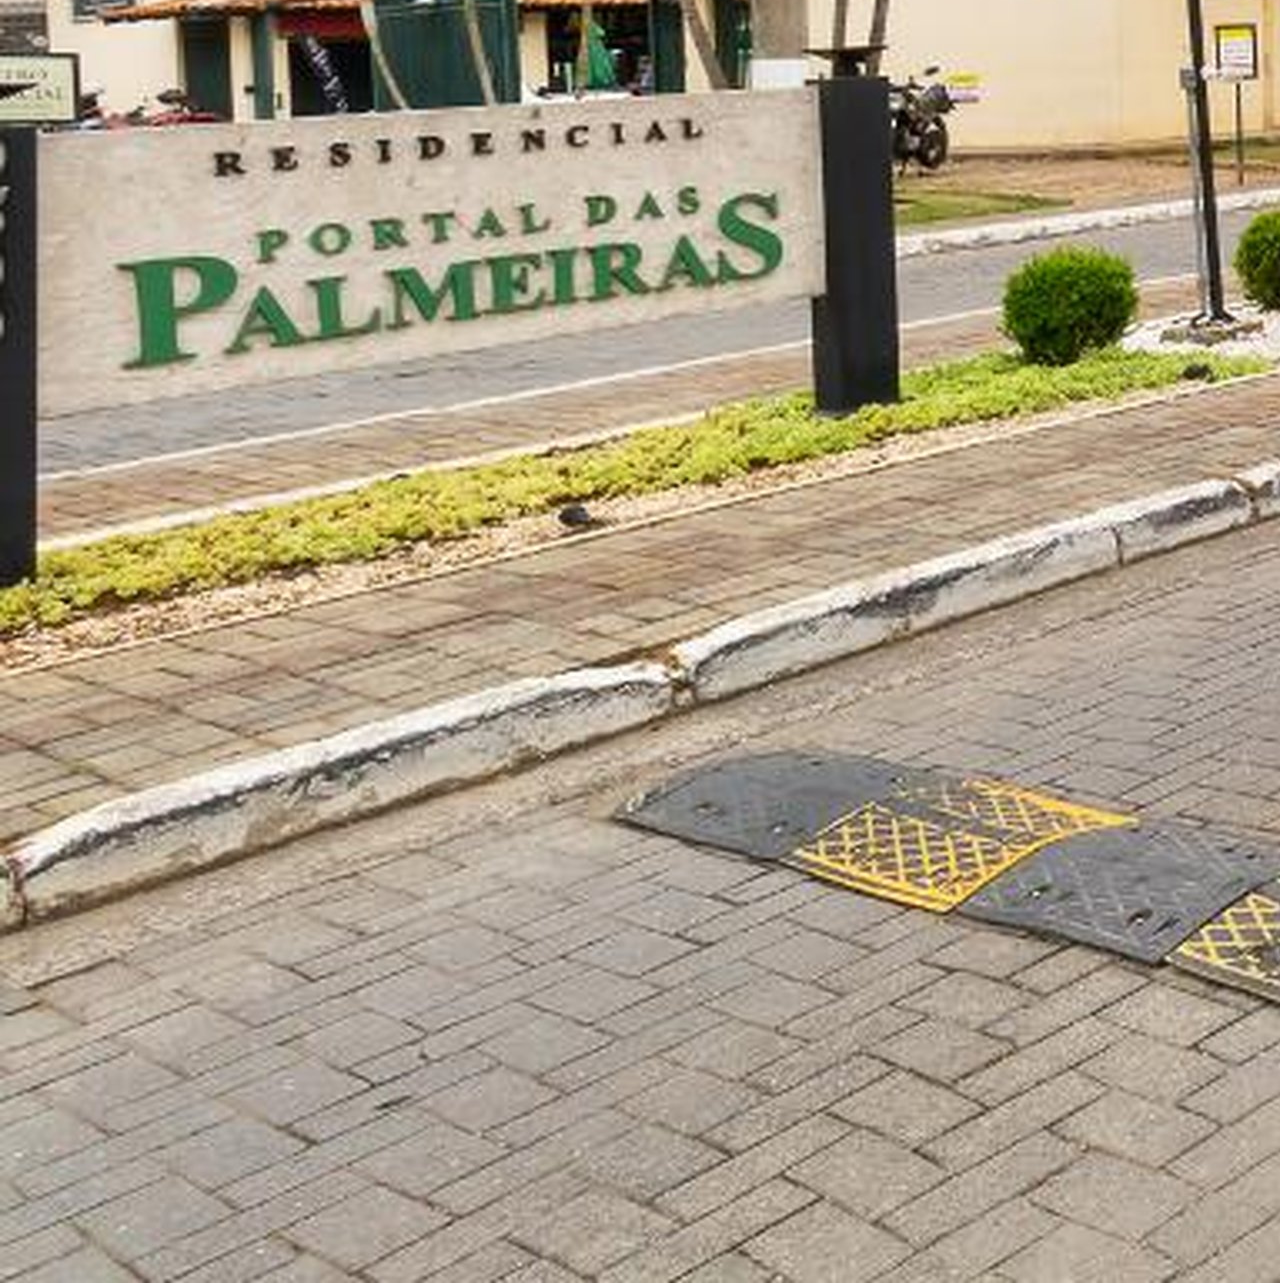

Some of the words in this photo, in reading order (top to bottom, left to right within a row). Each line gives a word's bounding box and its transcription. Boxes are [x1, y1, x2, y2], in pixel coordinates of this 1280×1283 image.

[213, 117, 704, 178] RESIDENCIAL
[254, 202, 551, 264] PORTAL
[584, 187, 699, 226] DAS
[115, 191, 784, 371] PALMEIRAS
